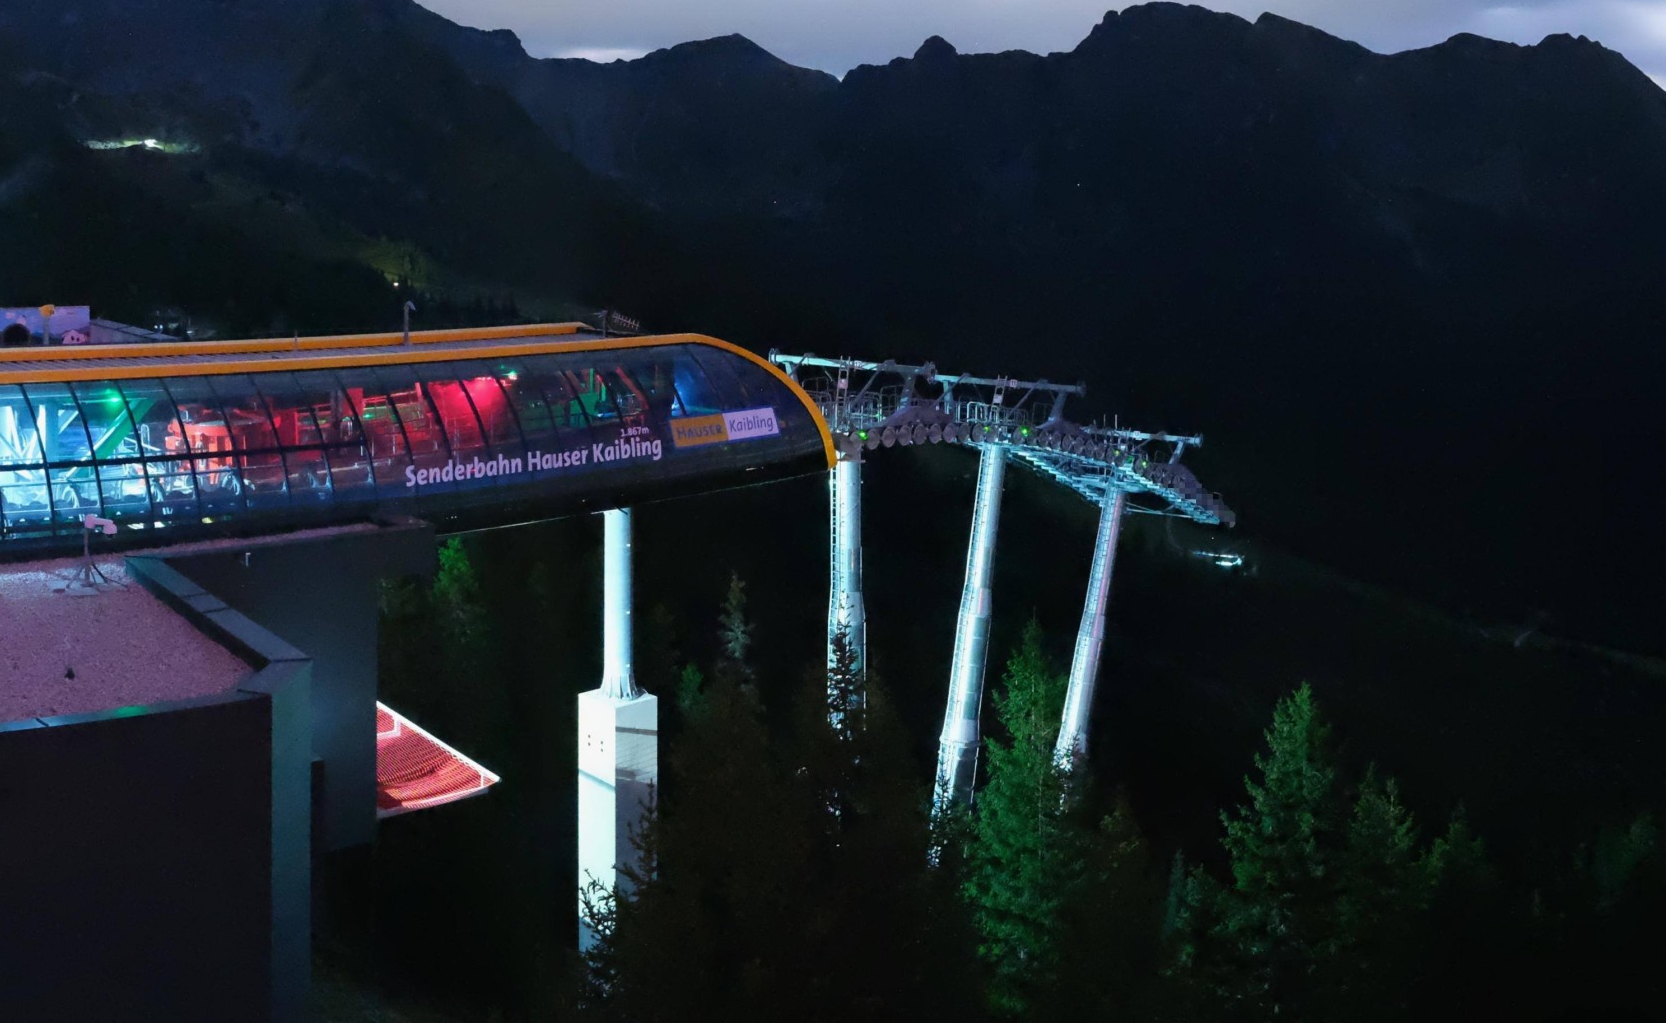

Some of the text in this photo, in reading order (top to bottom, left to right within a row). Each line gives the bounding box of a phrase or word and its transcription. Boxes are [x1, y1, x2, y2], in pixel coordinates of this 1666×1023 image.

[728, 415, 774, 433] Kaibling
[405, 436, 663, 487] Senderbahn Hauser Kaibling
